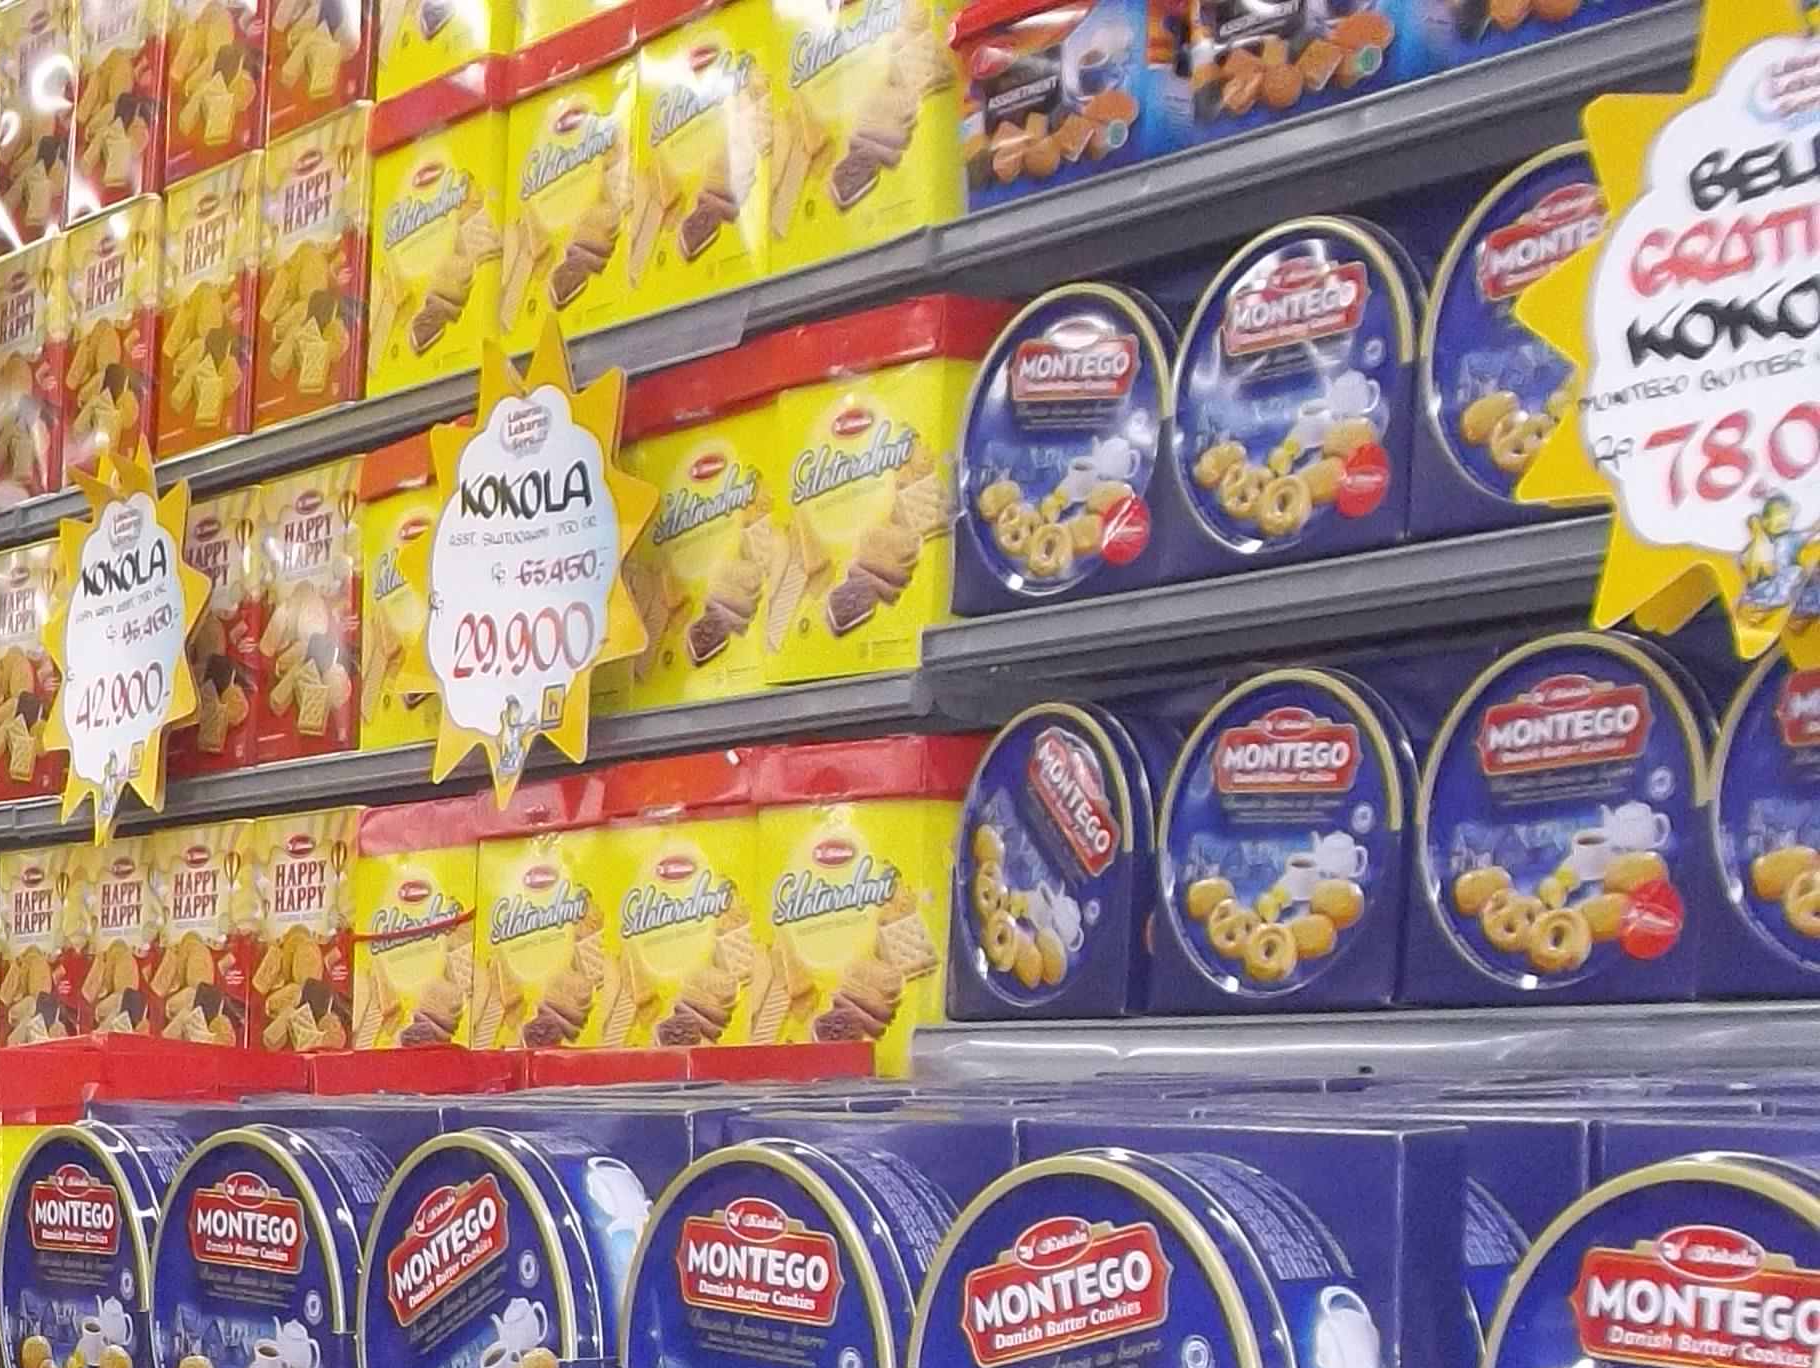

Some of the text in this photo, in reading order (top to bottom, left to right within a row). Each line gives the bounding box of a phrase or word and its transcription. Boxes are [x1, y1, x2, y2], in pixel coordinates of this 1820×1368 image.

[285, 174, 332, 208] HAPPY
[185, 215, 227, 249] HAPPY
[284, 198, 332, 234] HAPPY
[184, 241, 226, 275] HAPPY
[1490, 212, 1601, 274] MONTE
[86, 257, 125, 288] HAPPY
[0, 290, 36, 322] HAPPY
[85, 278, 124, 310] HAPPY
[1232, 280, 1356, 328] MONTEGO
[0, 315, 35, 345] HAPPY
[1020, 351, 1130, 379] MONTEGO
[790, 421, 917, 503] Silaturahmi
[461, 459, 593, 520] KOKOLA
[285, 512, 332, 544] HAPPY
[82, 538, 167, 598] KOKOLA
[284, 537, 332, 570] HAPPY
[1489, 704, 1639, 748] MONTEGO
[1225, 741, 1349, 768] MONTEGO
[1039, 745, 1110, 853] MONTEGO
[174, 869, 218, 896] HAPPY
[276, 861, 327, 888] HAPPY
[772, 855, 900, 926] Silaturahmi
[14, 889, 53, 912] HAPPY
[102, 880, 142, 905] HAPPY
[173, 894, 218, 920] HAPPY
[275, 886, 326, 913] HAPPY
[620, 872, 733, 939] Silaturahmi
[14, 911, 53, 935] HAPPY
[101, 904, 141, 929] HAPPY
[490, 880, 589, 944] Silaturahmi
[35, 1199, 114, 1229] MONTEGO
[197, 1208, 297, 1246] MONTEGO
[206, 1240, 289, 1262] Danish Butter Cookies
[394, 1197, 497, 1299] MONTEGO
[409, 1239, 492, 1308] Danish Butter Cookies
[689, 1240, 830, 1293] MONTEGO
[699, 1280, 817, 1312] Danish Butter Cookies
[974, 1252, 1153, 1332] MONTEGO
[995, 1300, 1142, 1350] Danish Butter Cookies
[1585, 1273, 1820, 1347] MONTEGO
[1609, 1325, 1673, 1350] Danish
[1676, 1331, 1737, 1358] Butter
